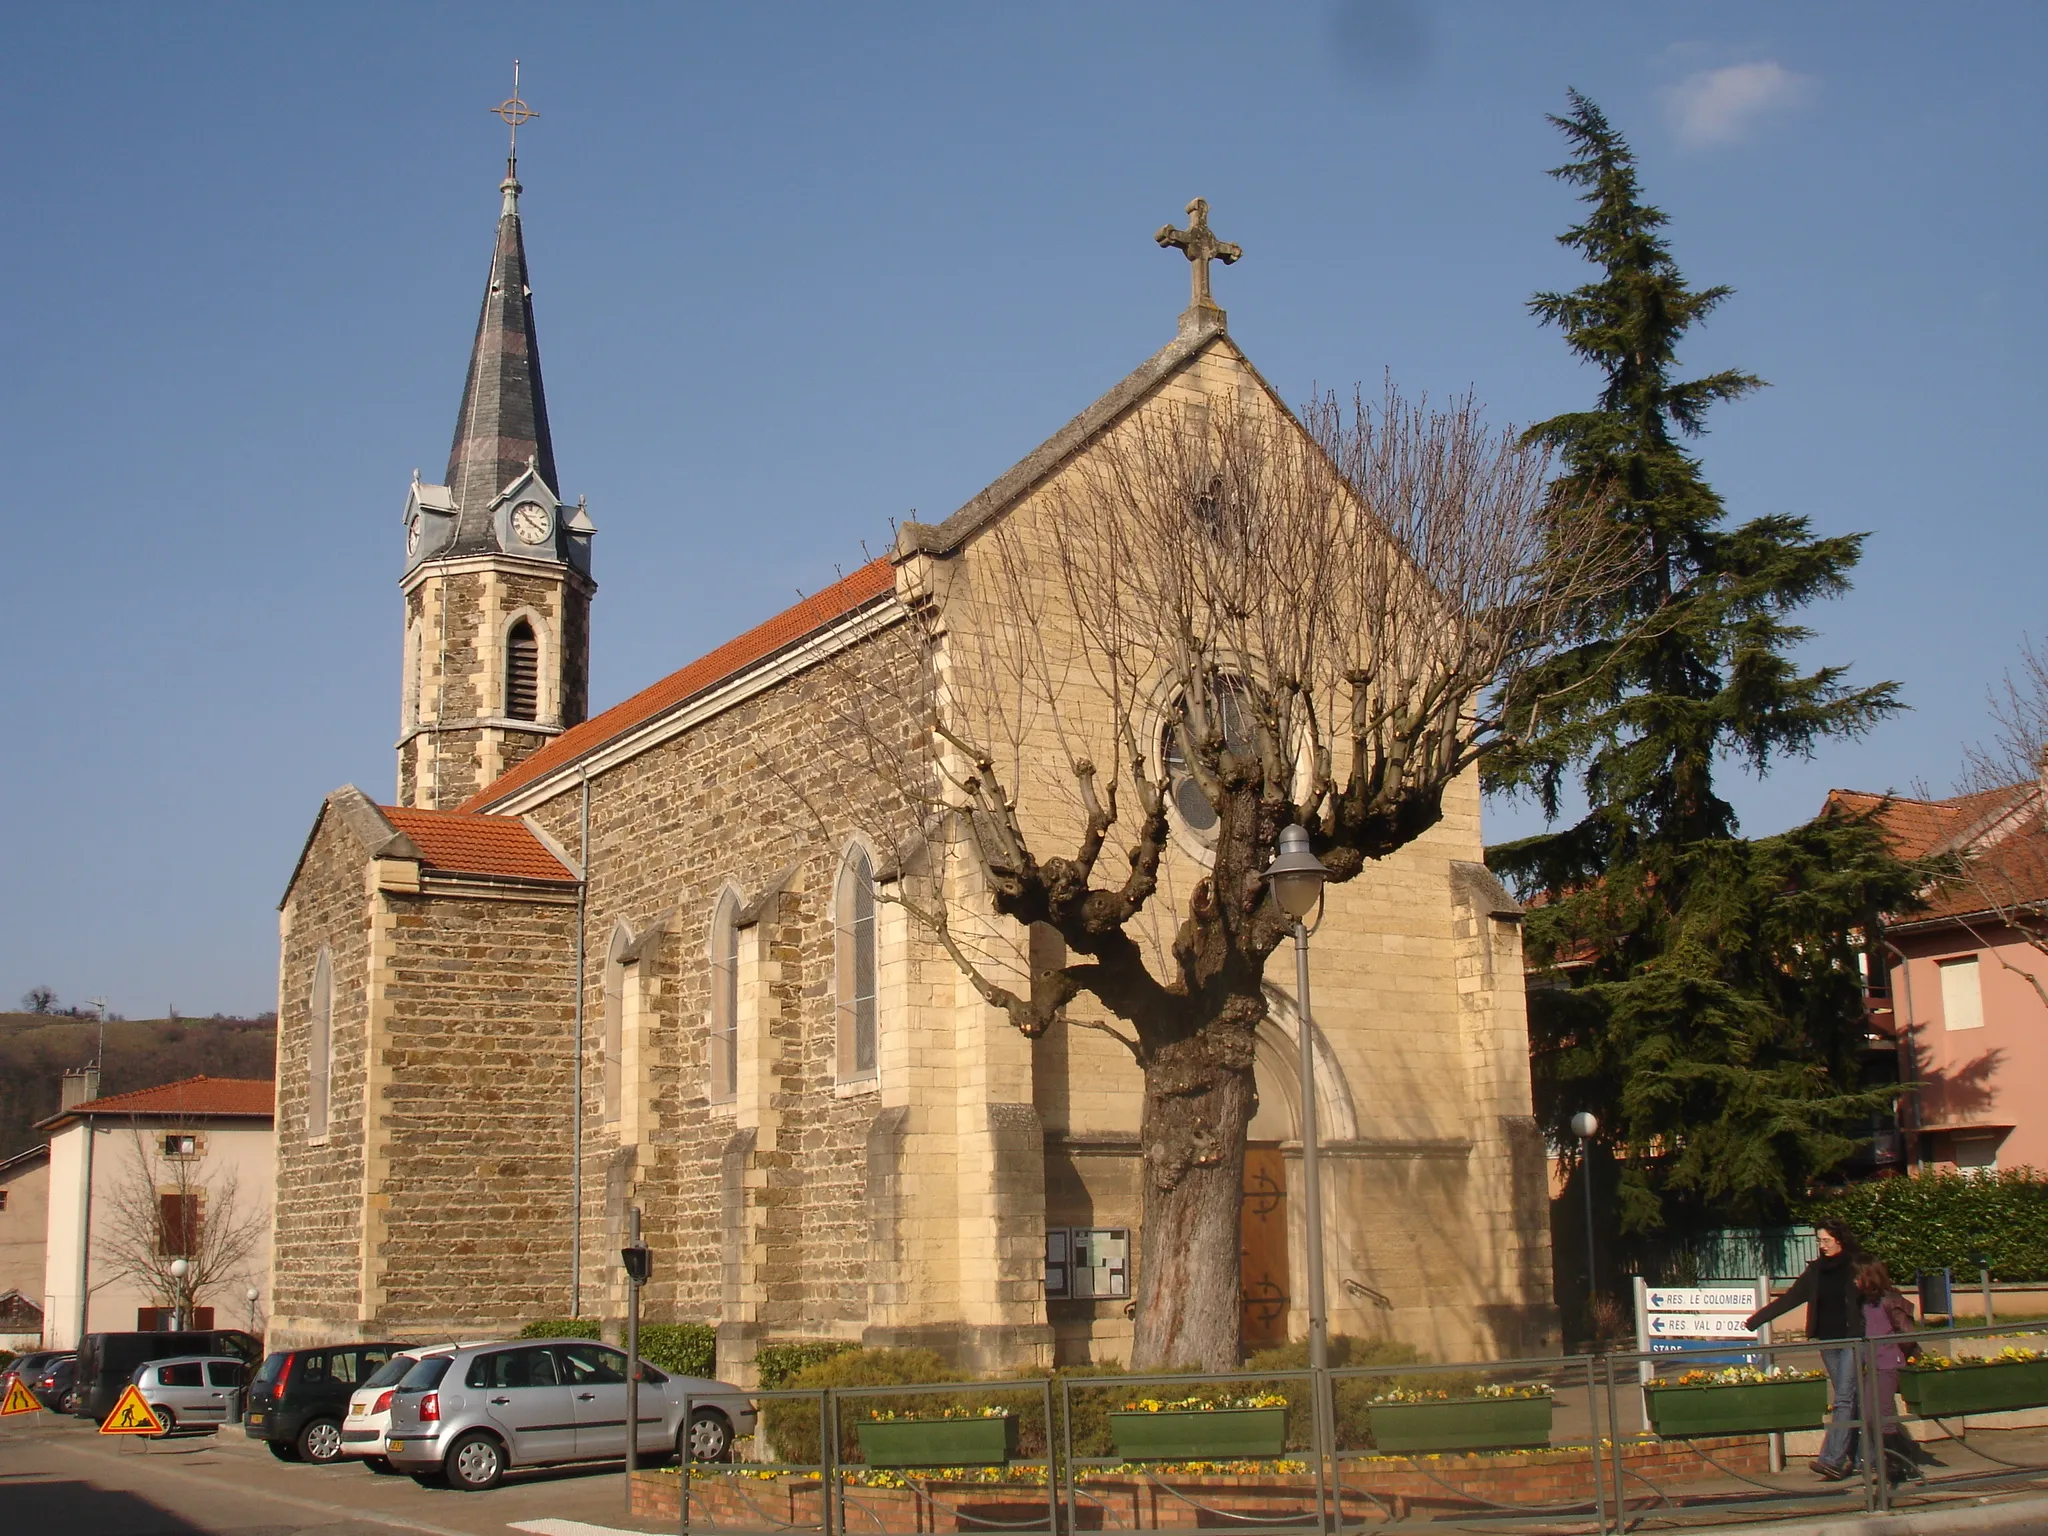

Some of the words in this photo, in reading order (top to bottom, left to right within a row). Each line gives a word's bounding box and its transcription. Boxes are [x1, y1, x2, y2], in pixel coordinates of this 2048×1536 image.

[1667, 1295, 1686, 1305] RES.
[1690, 1295, 1700, 1305] LE
[1704, 1295, 1752, 1305] COLOMBIER
[1669, 1320, 1688, 1330] RES.
[1694, 1320, 1710, 1331] VAL
